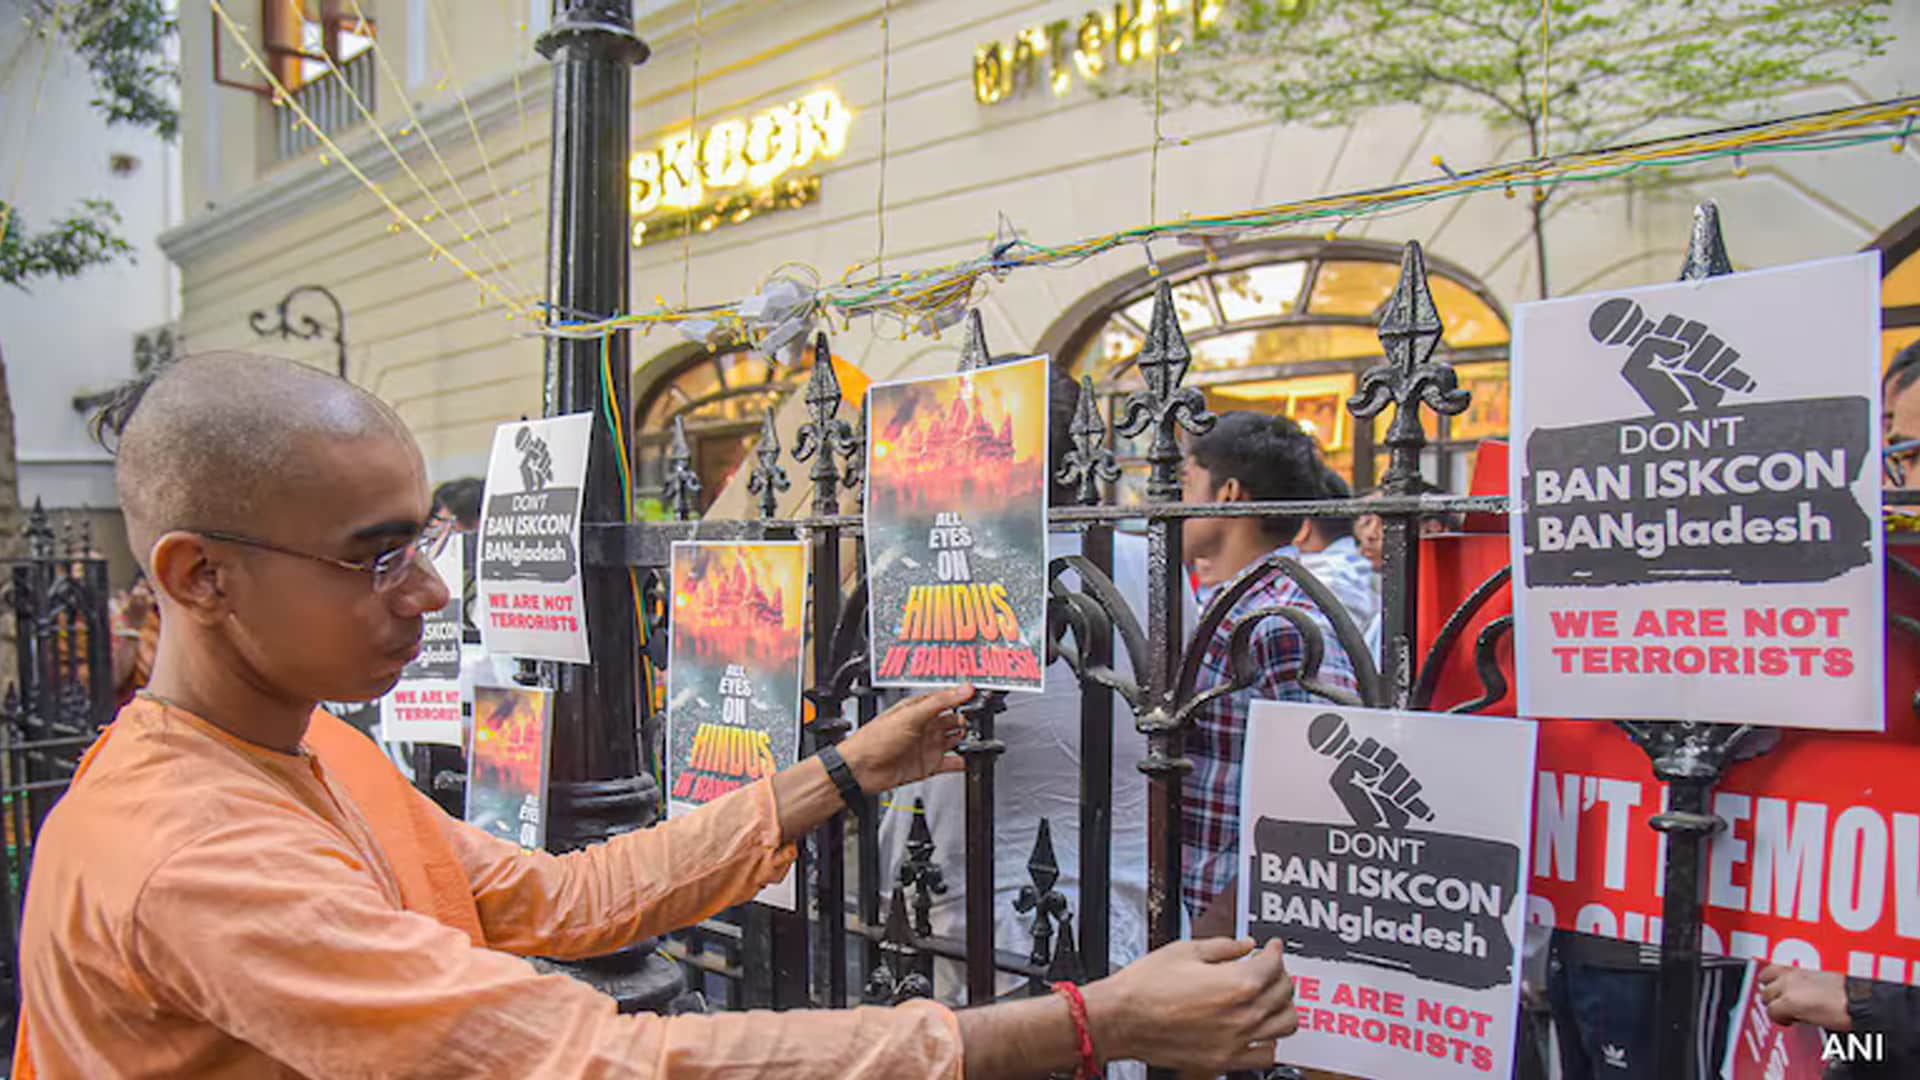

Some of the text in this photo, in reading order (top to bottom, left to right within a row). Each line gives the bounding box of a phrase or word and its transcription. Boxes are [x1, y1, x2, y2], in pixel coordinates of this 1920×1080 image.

[630, 86, 851, 213] SKCON
[1619, 416, 1744, 455] DON'T
[1534, 448, 1846, 505] BAN ISKCON
[512, 494, 548, 511] DON'T
[486, 513, 571, 536] BAN ISKCON
[935, 512, 962, 526] ALL
[1538, 502, 1832, 559] BANgladesh
[485, 540, 566, 566] BANgladesh
[929, 527, 973, 549] EYES
[938, 550, 971, 581] ON
[489, 594, 573, 611] WE ARE NOT
[898, 582, 1020, 641] HINDUS
[490, 613, 578, 632] TERRORISTS
[1550, 608, 1849, 638] WE ARE NOT
[877, 645, 1042, 681] IN BANGLADESH
[1552, 646, 1854, 678] TERRORISTS
[395, 691, 416, 703] WE
[719, 677, 752, 696] EYES
[722, 697, 747, 726] ON
[689, 722, 776, 780] HINDUS
[671, 771, 696, 797] IN
[1328, 828, 1426, 865] DON'T
[1534, 771, 1642, 891] N'T
[1260, 852, 1338, 891] BAN
[1348, 864, 1501, 918] ISKCON
[1260, 892, 1489, 958] BANgladesh
[1290, 975, 1493, 1038] E ARE NOT
[1295, 1005, 1494, 1073] ERRORISTS
